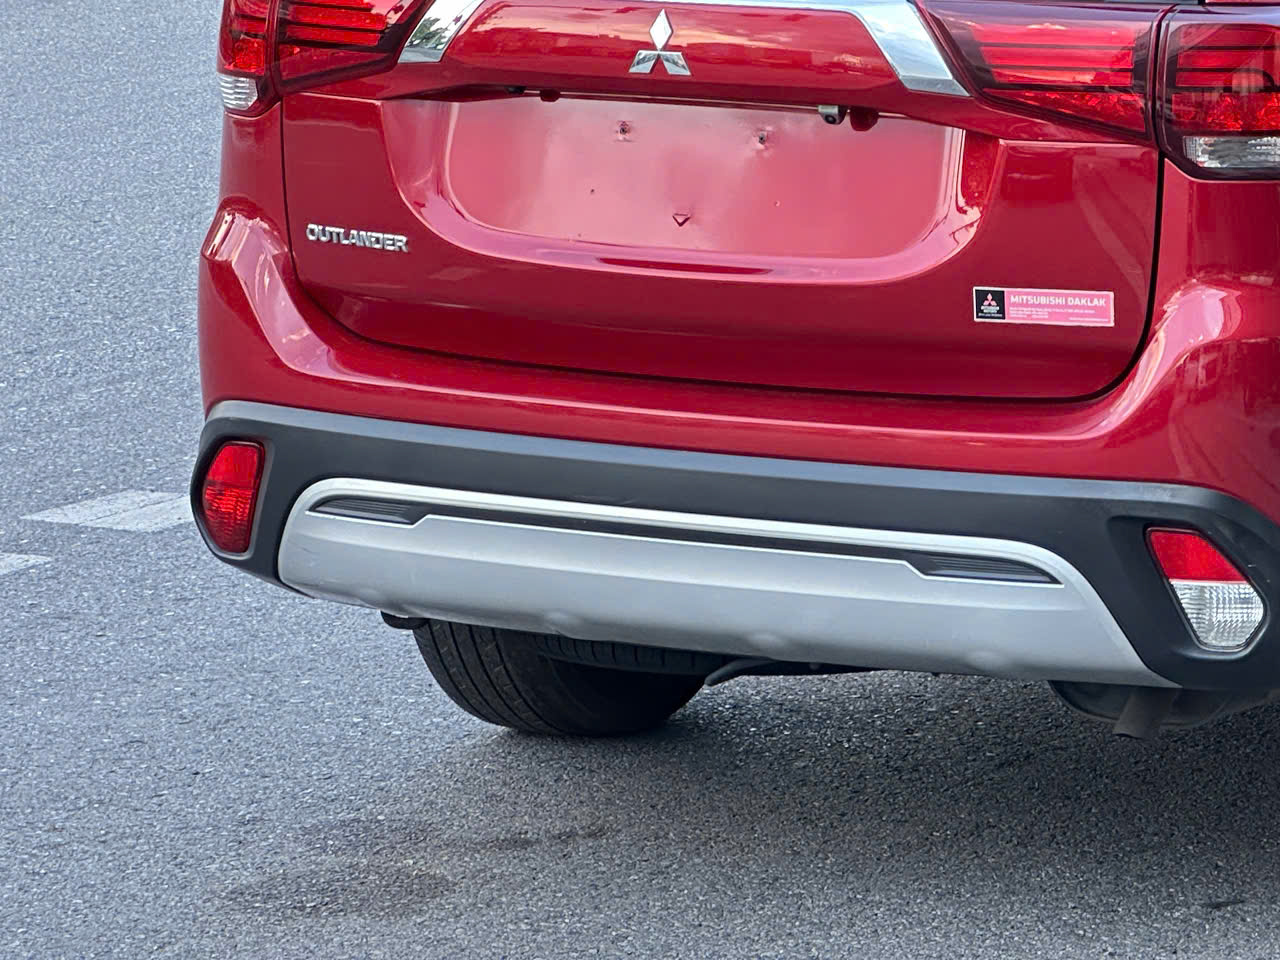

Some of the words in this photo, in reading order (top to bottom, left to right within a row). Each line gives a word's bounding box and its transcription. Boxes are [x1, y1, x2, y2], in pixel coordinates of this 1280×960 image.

[306, 224, 409, 252] OUTLANDER
[1010, 295, 1065, 305] MITSUBISHI
[1068, 297, 1107, 307] DAKLAK
